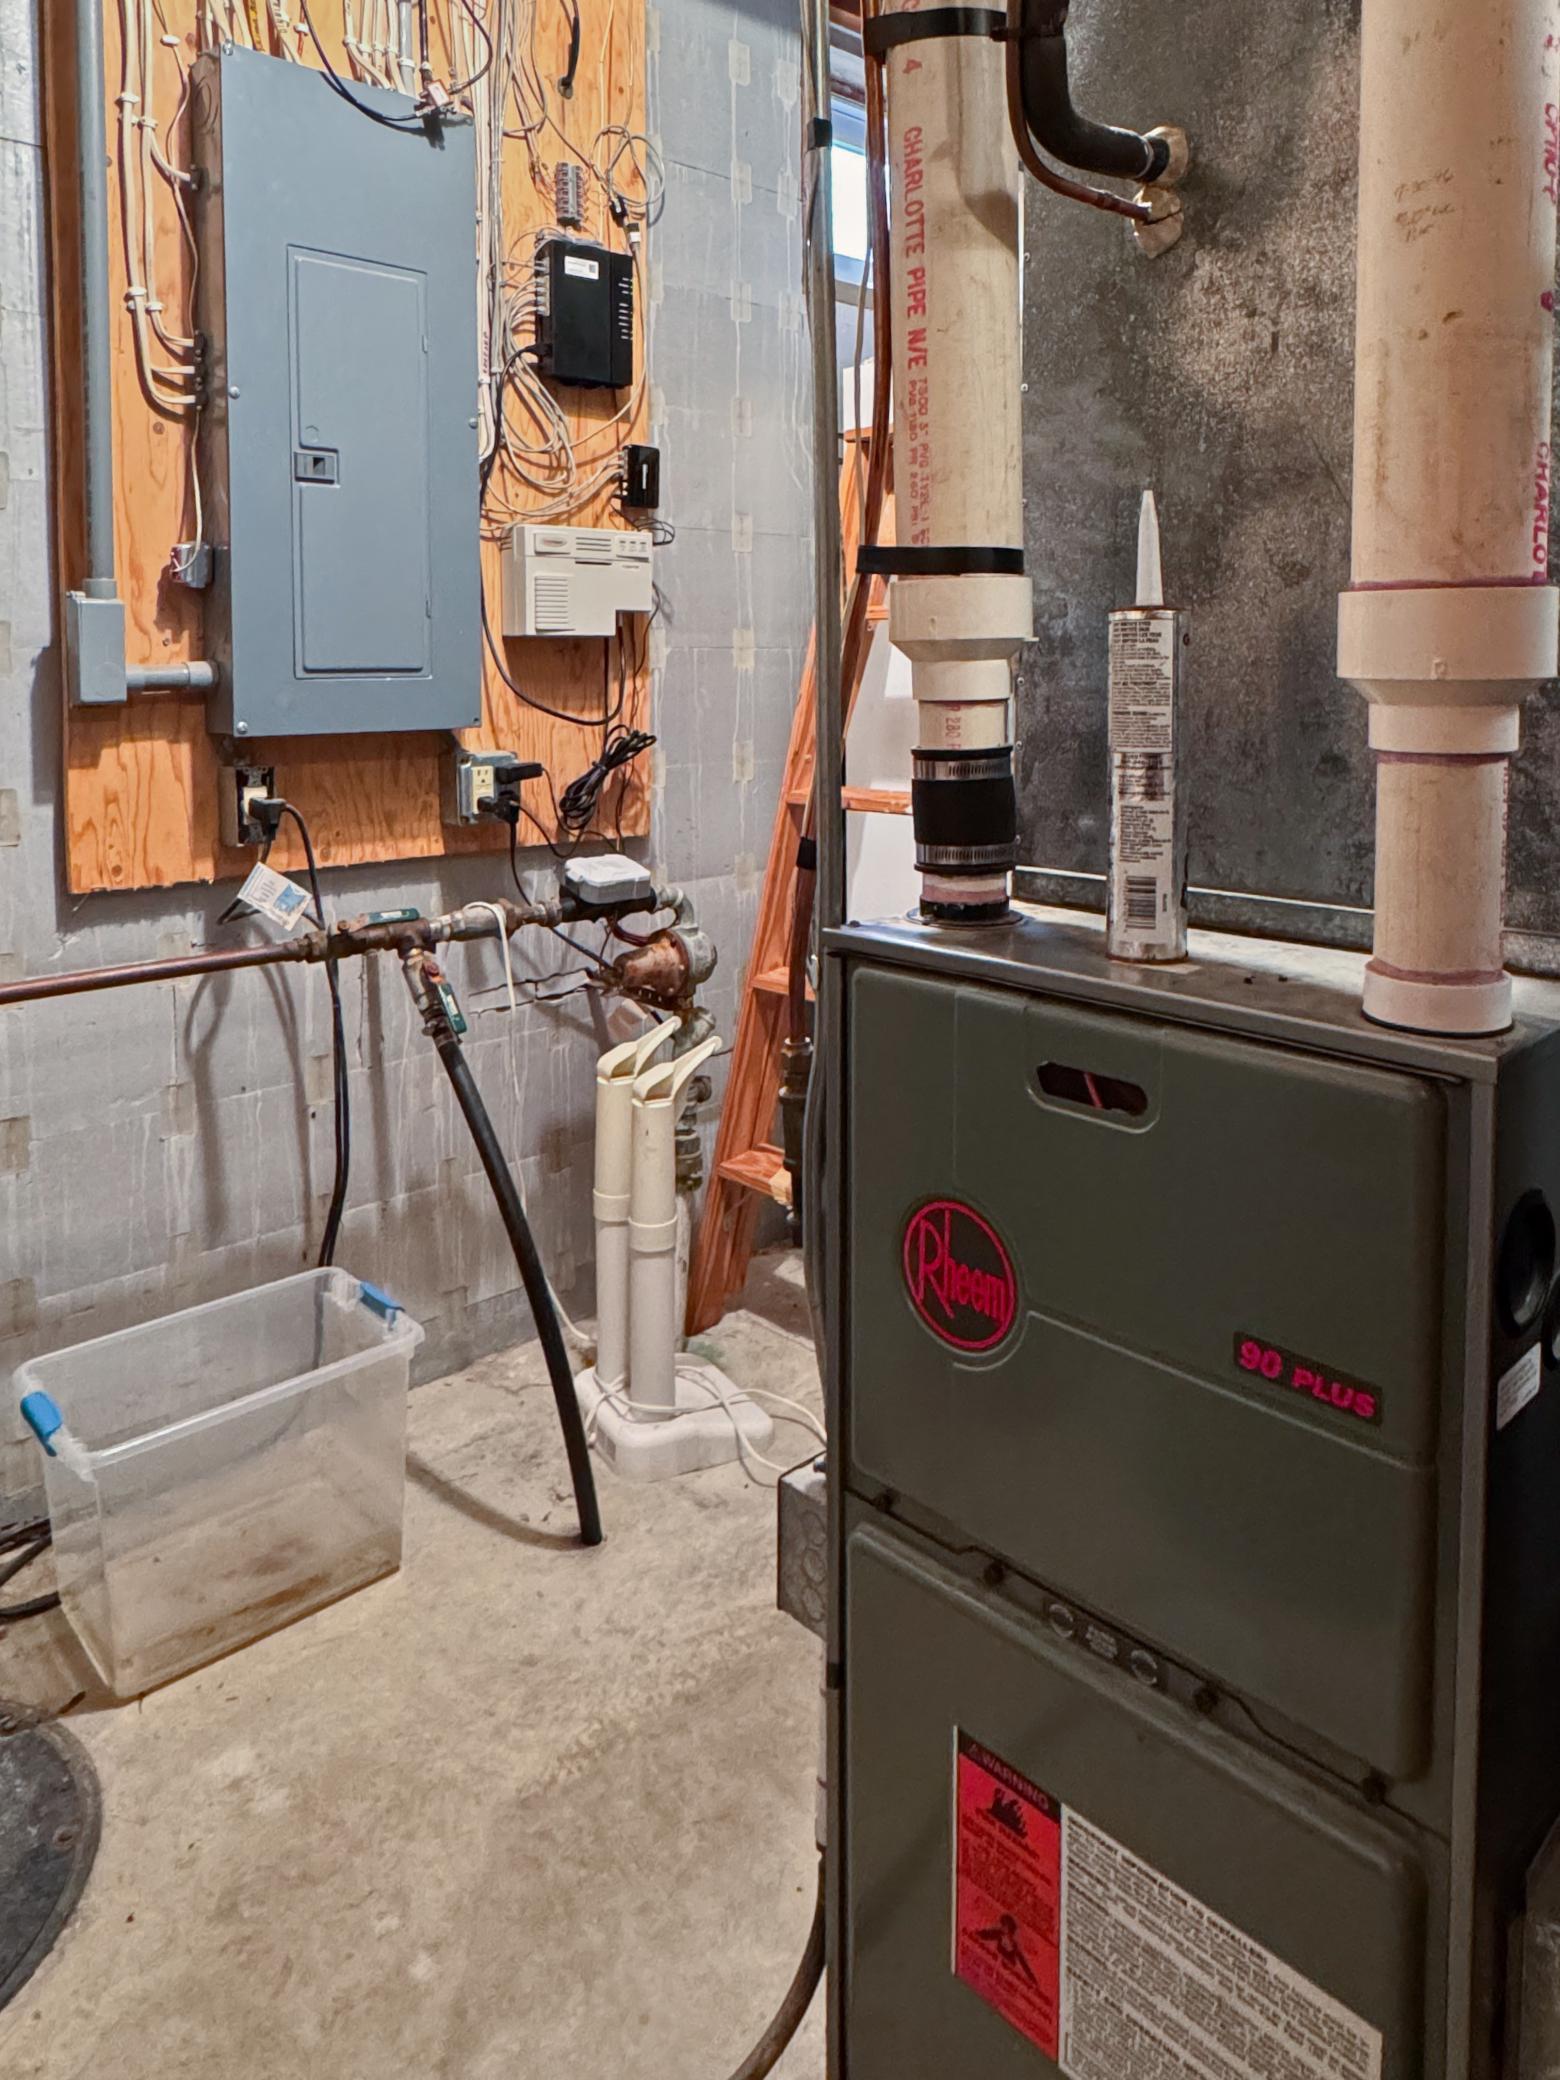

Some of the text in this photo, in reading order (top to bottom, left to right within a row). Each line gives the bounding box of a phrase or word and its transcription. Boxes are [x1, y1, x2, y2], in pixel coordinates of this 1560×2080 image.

[903, 126, 926, 258] CHARLOTTE
[907, 266, 927, 319] PIPE
[908, 328, 929, 370] N/E
[913, 1206, 1010, 1329] Rheem
[1239, 1341, 1376, 1418] 90 PLUS
